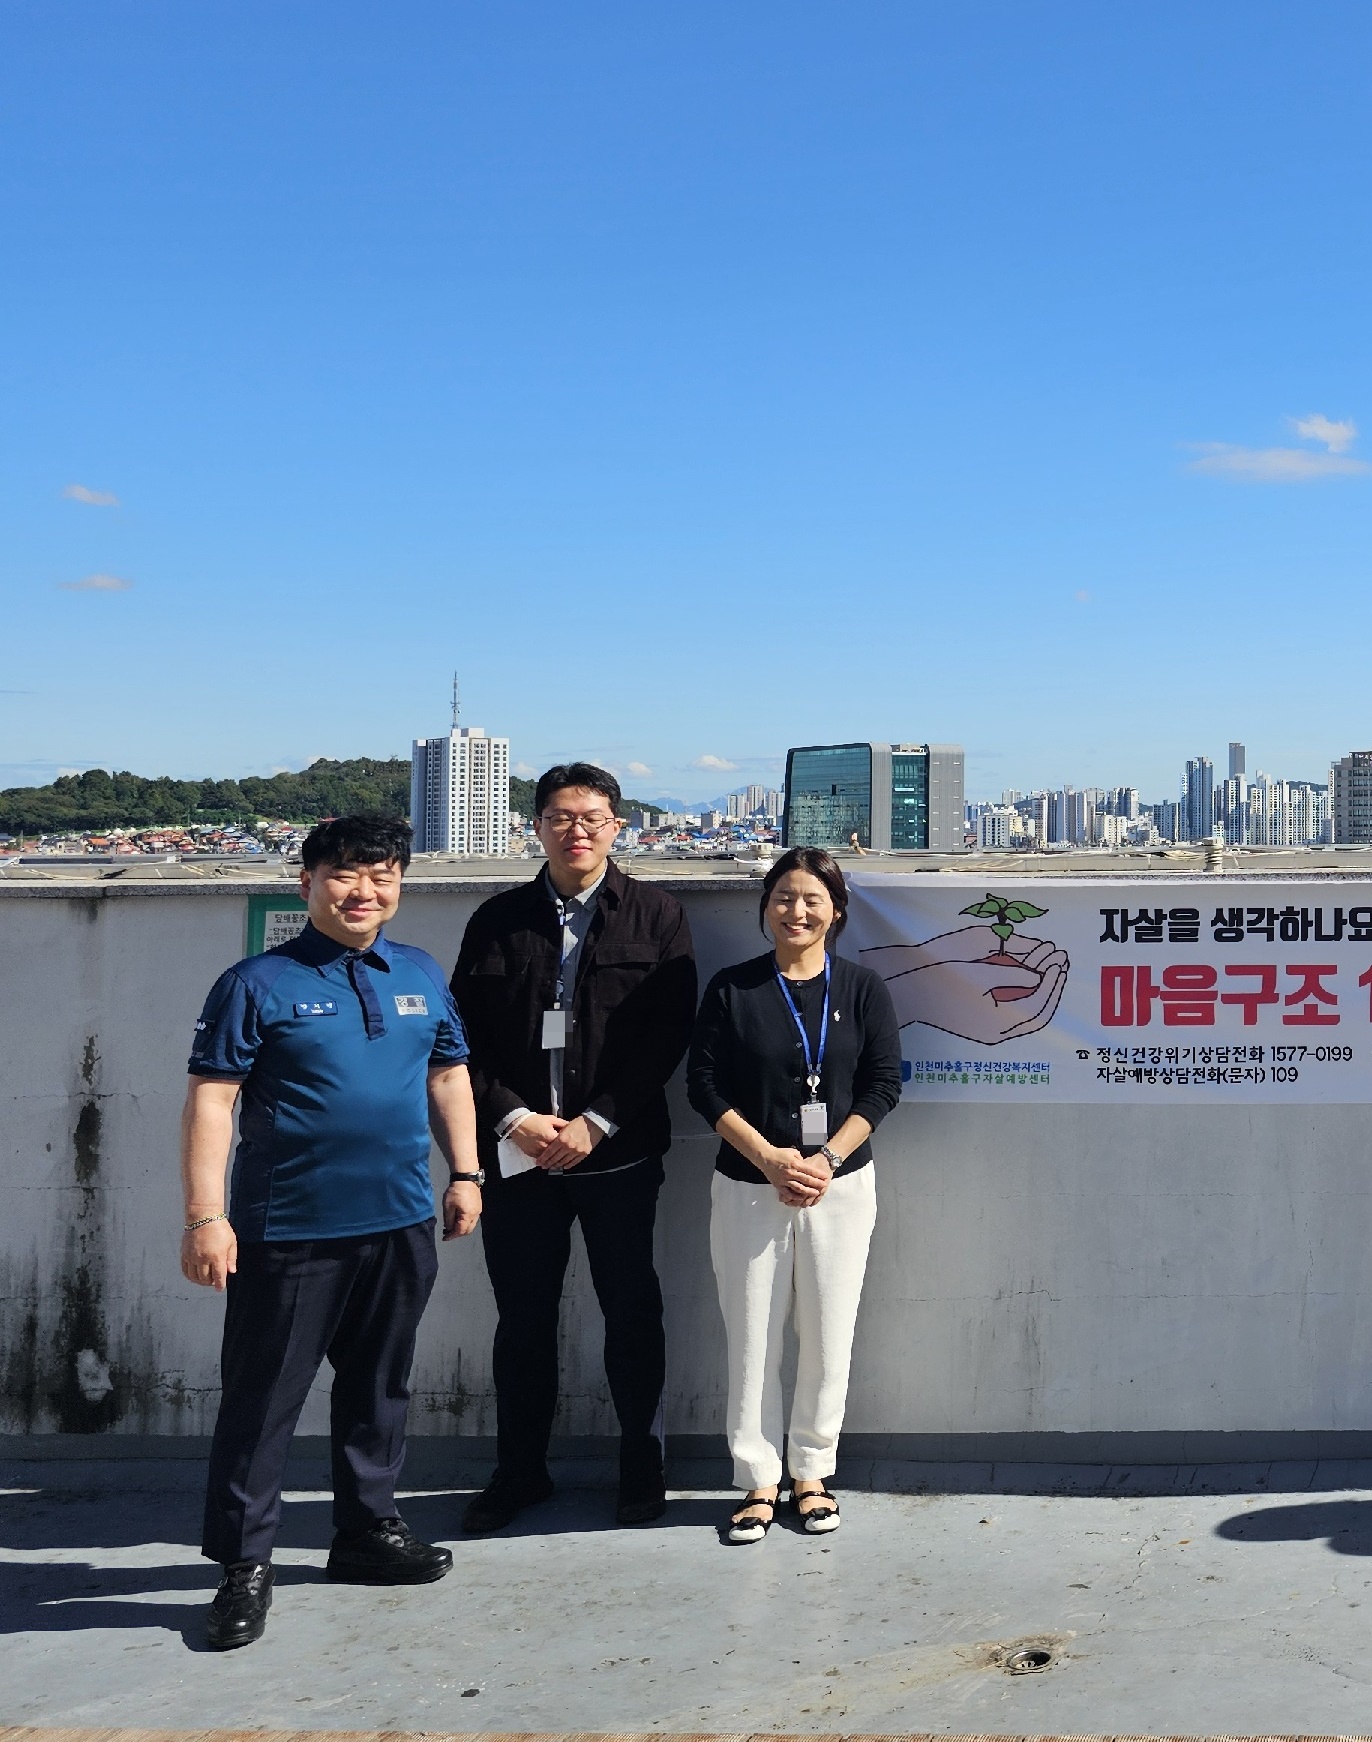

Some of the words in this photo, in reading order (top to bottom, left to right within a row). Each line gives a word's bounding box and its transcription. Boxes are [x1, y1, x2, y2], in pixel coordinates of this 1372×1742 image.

[1099, 908, 1200, 943] 자살을
[1100, 964, 1341, 1027] 마음구조
[1097, 1047, 1265, 1064] 정신건강위기상담전화
[1271, 1046, 1353, 1062] 1577-0199
[915, 1061, 1050, 1073] 인천미추홀구정신건강복지센터
[1097, 1067, 1266, 1084] 자살예방상담전화(문자)
[1271, 1067, 1298, 1082] 109
[915, 1073, 1050, 1085] 인천미추홀구자살예방센터
